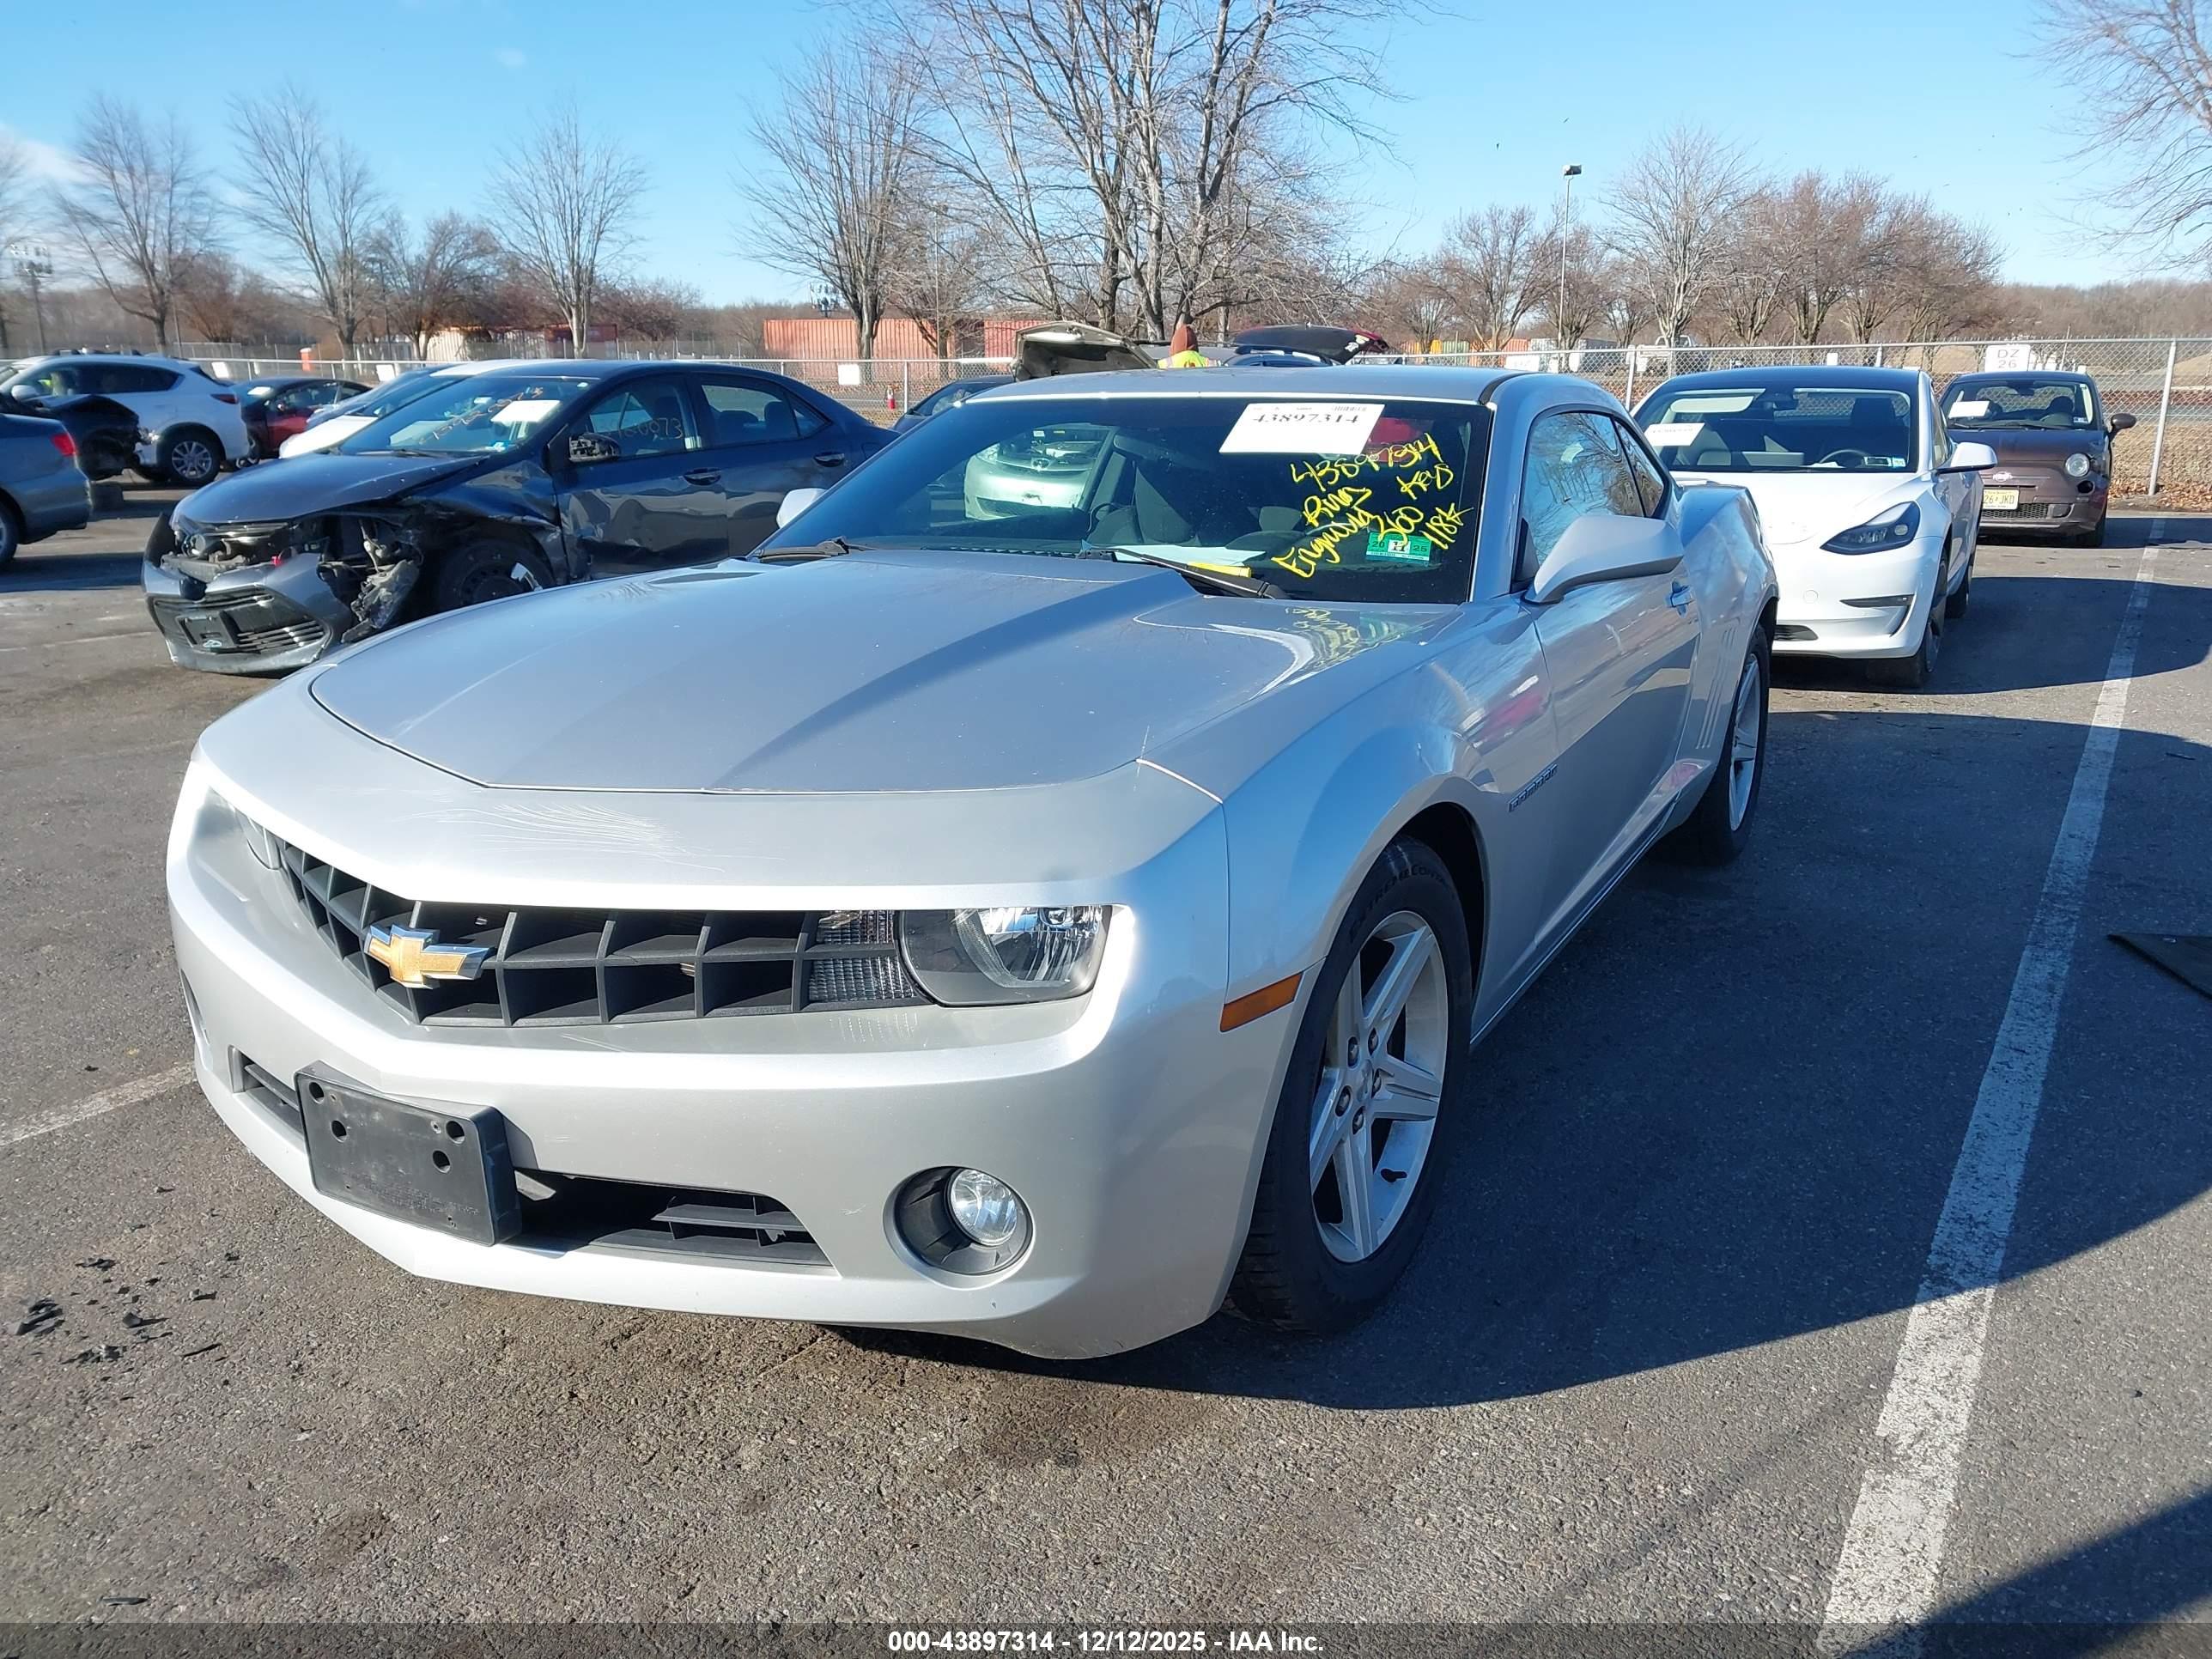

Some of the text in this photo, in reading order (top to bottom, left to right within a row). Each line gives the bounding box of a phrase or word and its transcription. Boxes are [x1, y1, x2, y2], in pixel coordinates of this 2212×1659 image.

[1997, 349, 2020, 358] DZ
[1998, 360, 2017, 368] 26
[1253, 414, 1358, 423] 43897314
